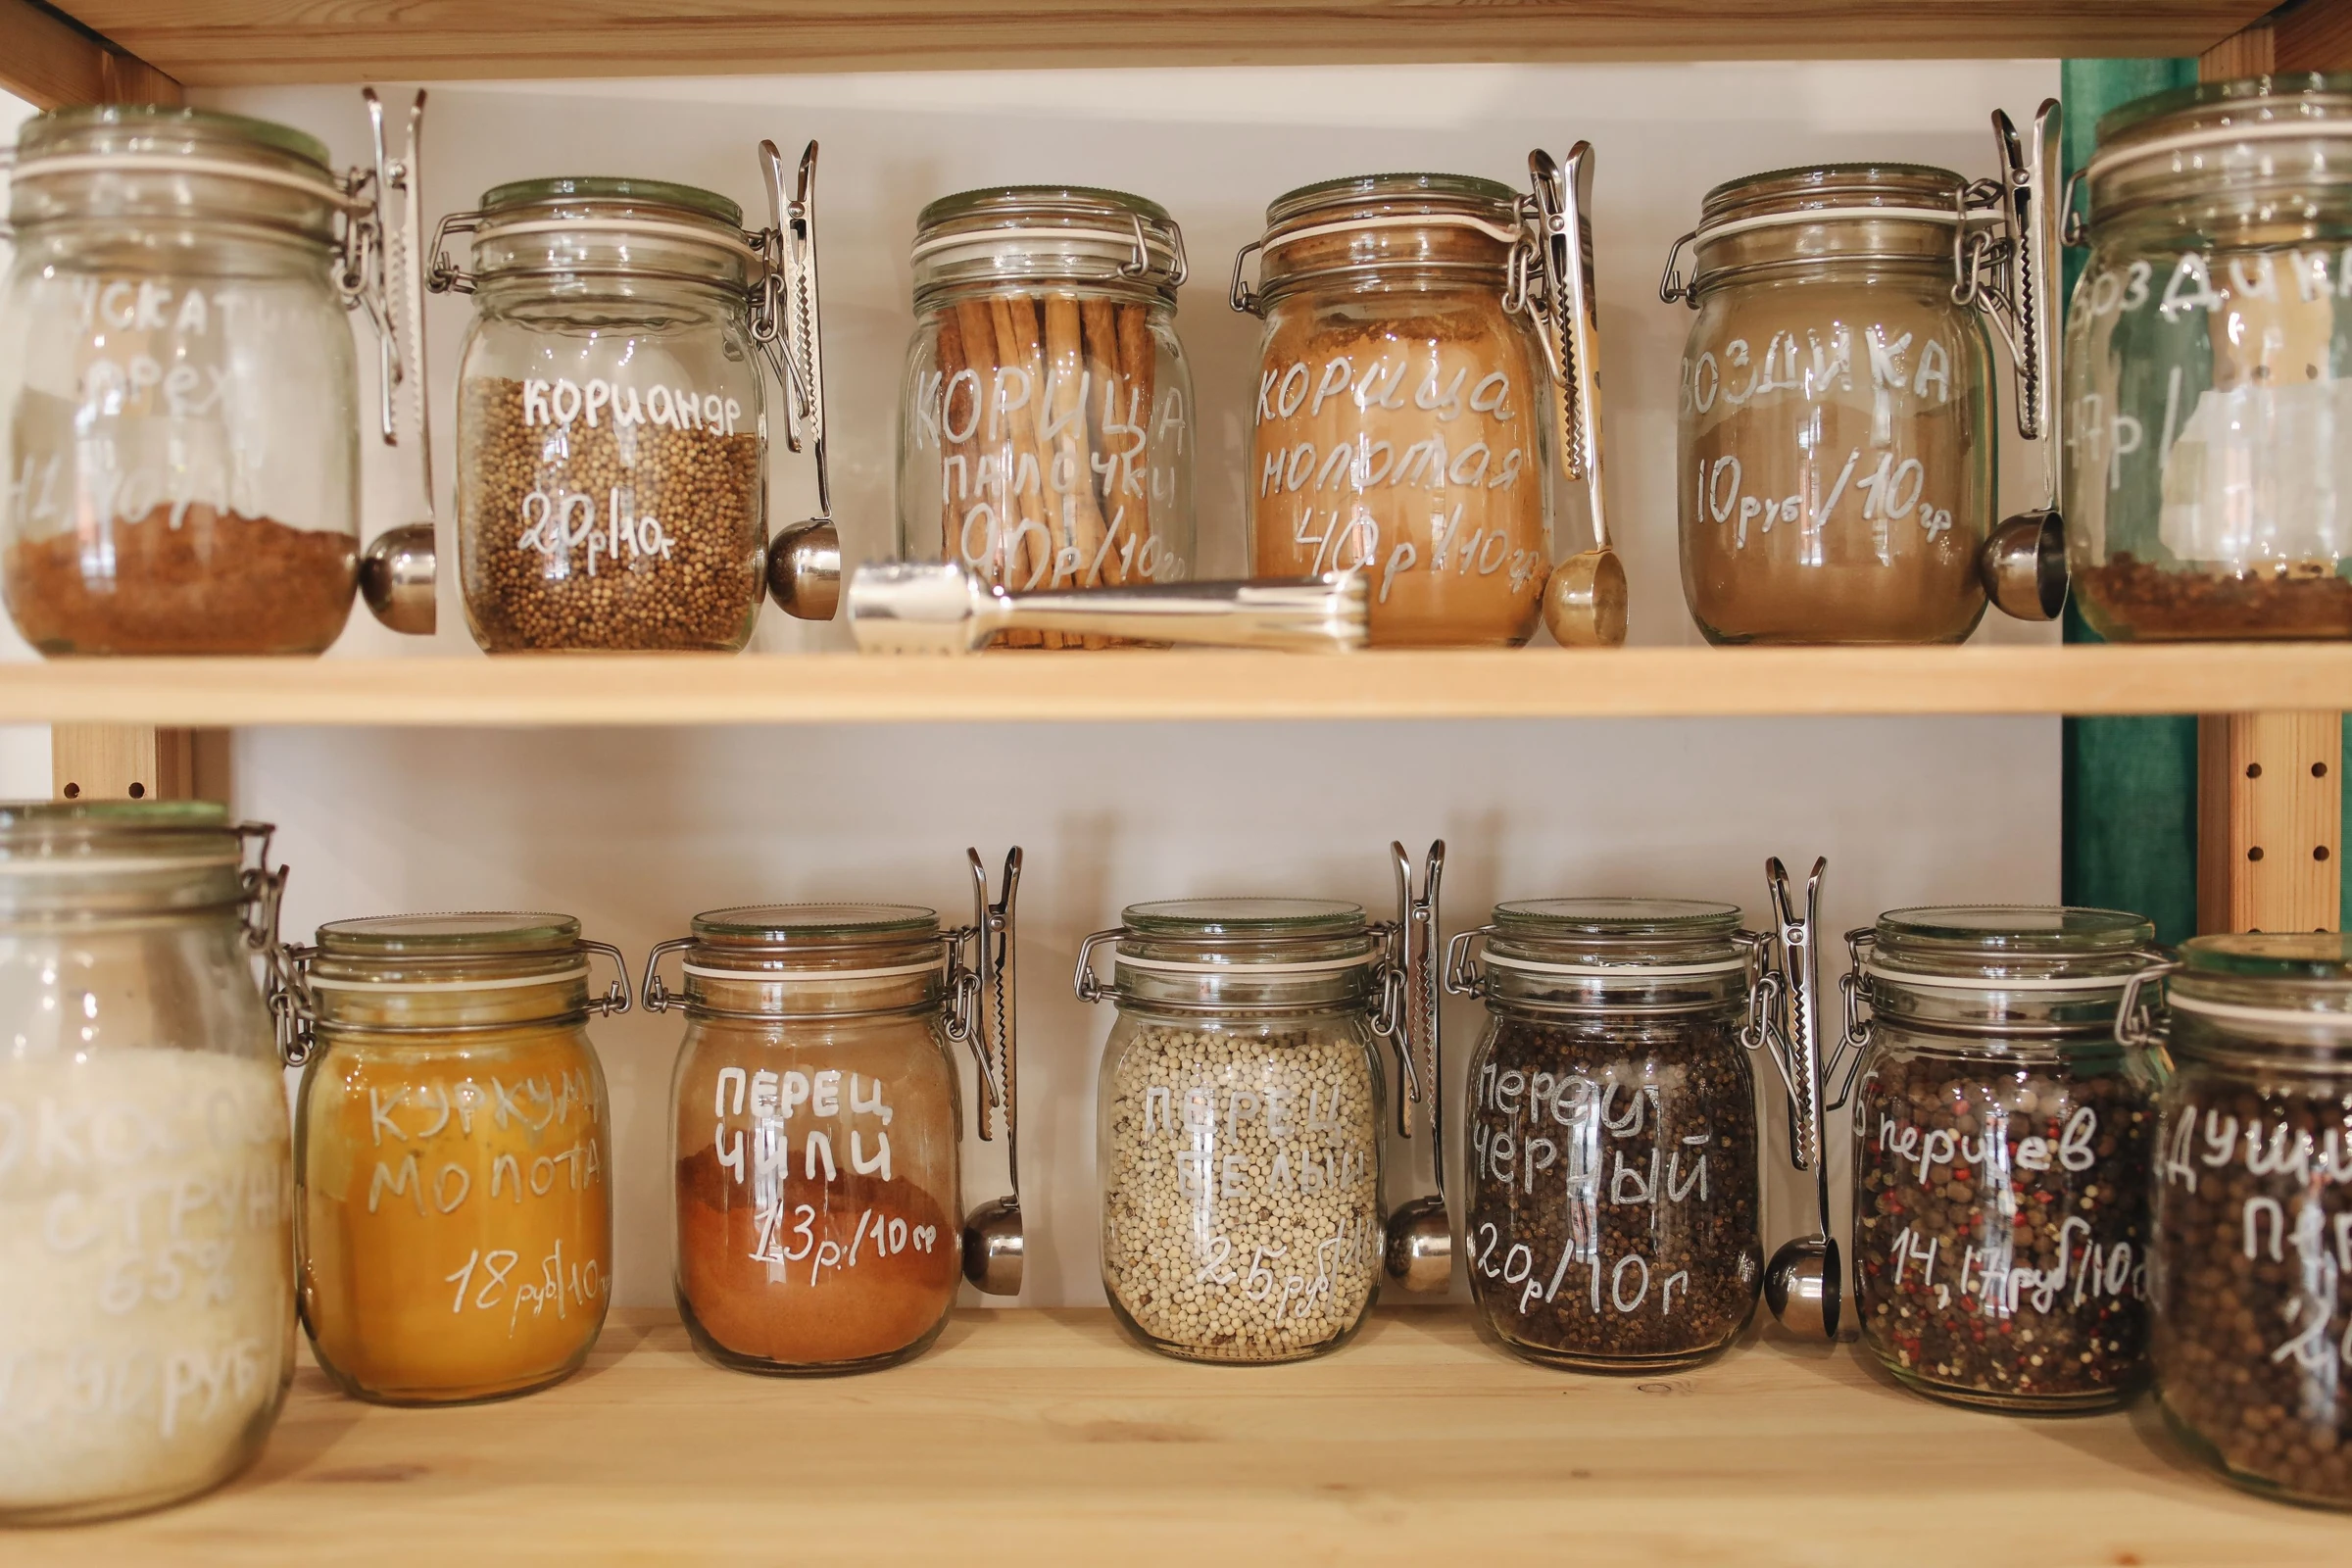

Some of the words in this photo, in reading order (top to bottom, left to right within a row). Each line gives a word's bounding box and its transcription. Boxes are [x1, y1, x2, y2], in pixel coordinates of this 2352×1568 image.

[916, 366, 1187, 458] КОРИЦА
[1261, 441, 1521, 499] молотая
[714, 1066, 893, 1125] ПЕРЕЦ
[1144, 1084, 1345, 1147] ПЕРЕЦ
[714, 1122, 892, 1184] ЧИЛИ
[1879, 1106, 2098, 1184] перцев
